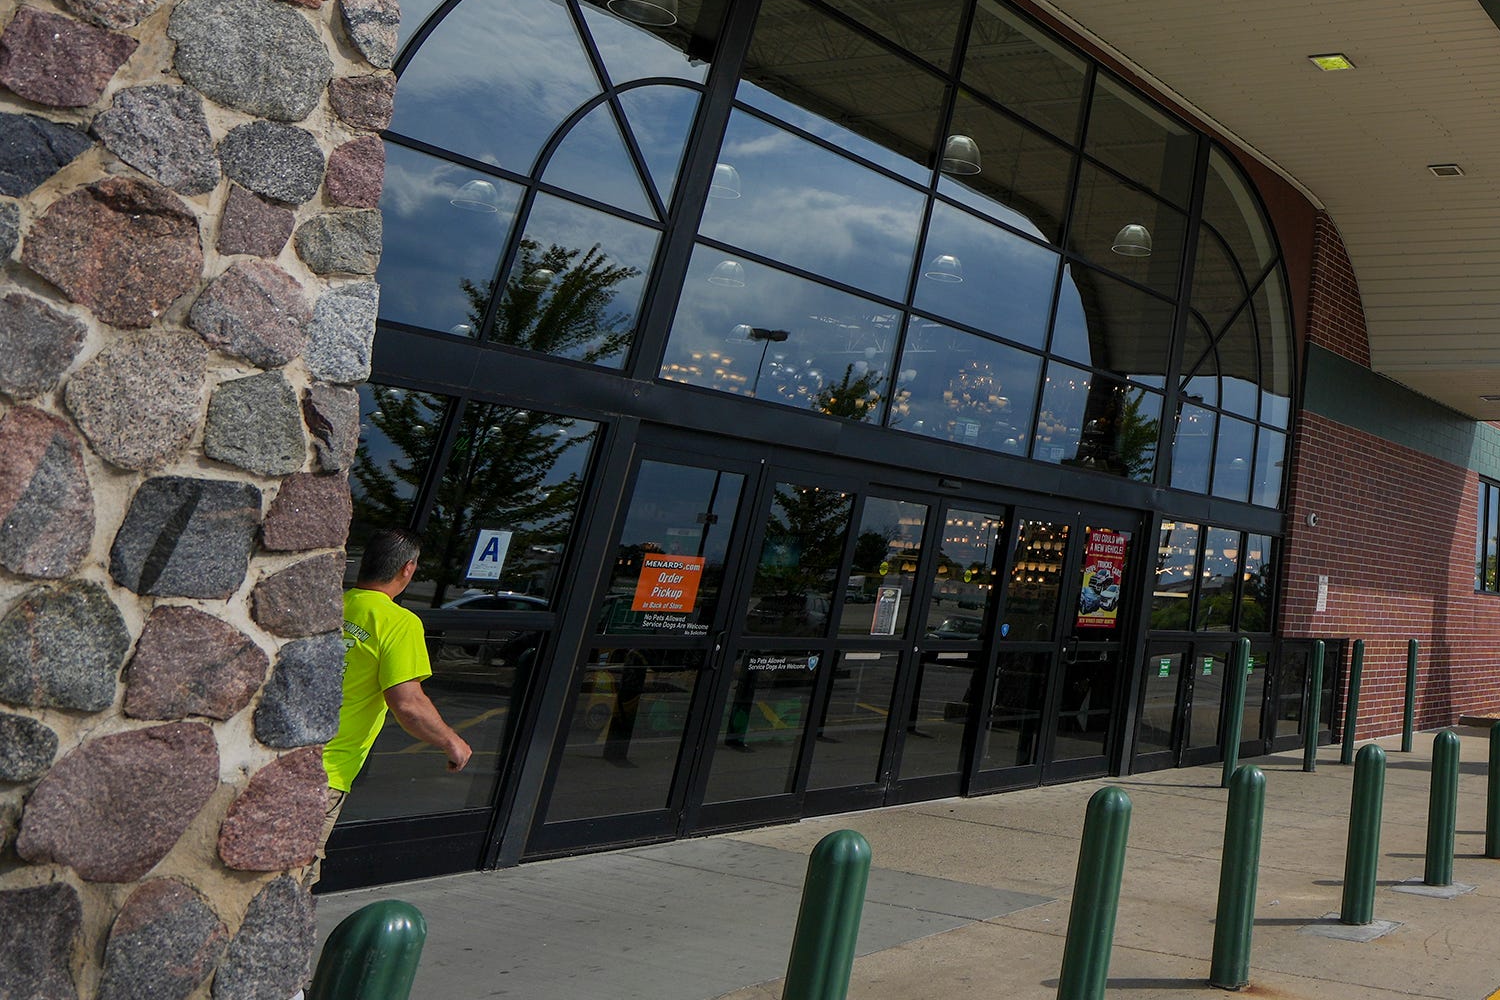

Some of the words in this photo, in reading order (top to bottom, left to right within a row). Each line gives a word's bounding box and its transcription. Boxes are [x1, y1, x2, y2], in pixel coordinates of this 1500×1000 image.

[479, 537, 499, 562] A
[658, 572, 684, 584] Order
[651, 586, 683, 600] Pickup
[642, 620, 662, 628] Service
[662, 621, 676, 630] Dogs
